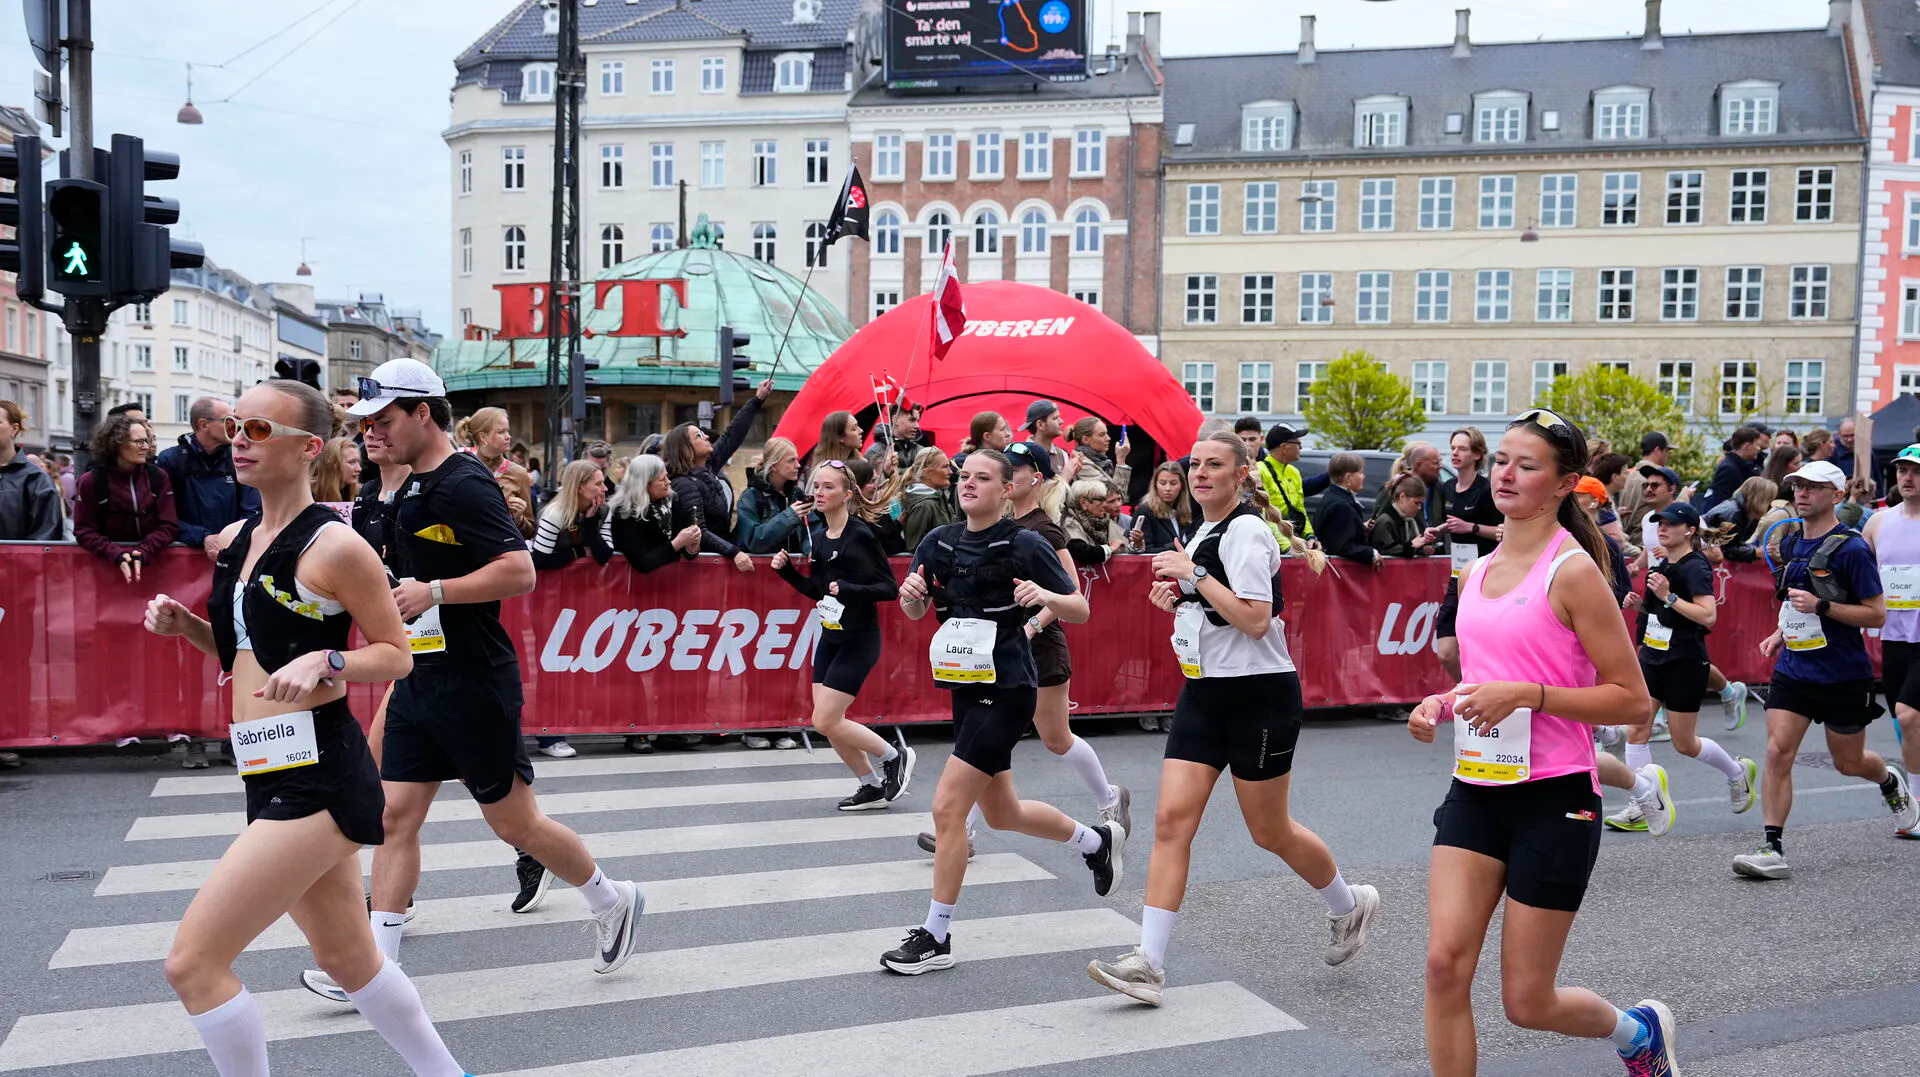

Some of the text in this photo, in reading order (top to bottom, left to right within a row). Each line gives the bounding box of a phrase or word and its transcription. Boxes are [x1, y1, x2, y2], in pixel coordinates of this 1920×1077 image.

[916, 18, 960, 31] Ta' den
[905, 31, 971, 46] smarte vej
[1889, 582, 1912, 590] Oscar
[420, 628, 440, 637] 24523
[1786, 621, 1806, 631] Asger
[946, 643, 973, 655] Laura
[236, 723, 296, 746] Sabriella
[1468, 722, 1500, 739] Fra
[1258, 728, 1269, 769] ENDURANCE
[285, 750, 313, 763] 16021
[1495, 753, 1524, 764] 22034
[919, 948, 937, 961] HOKA
